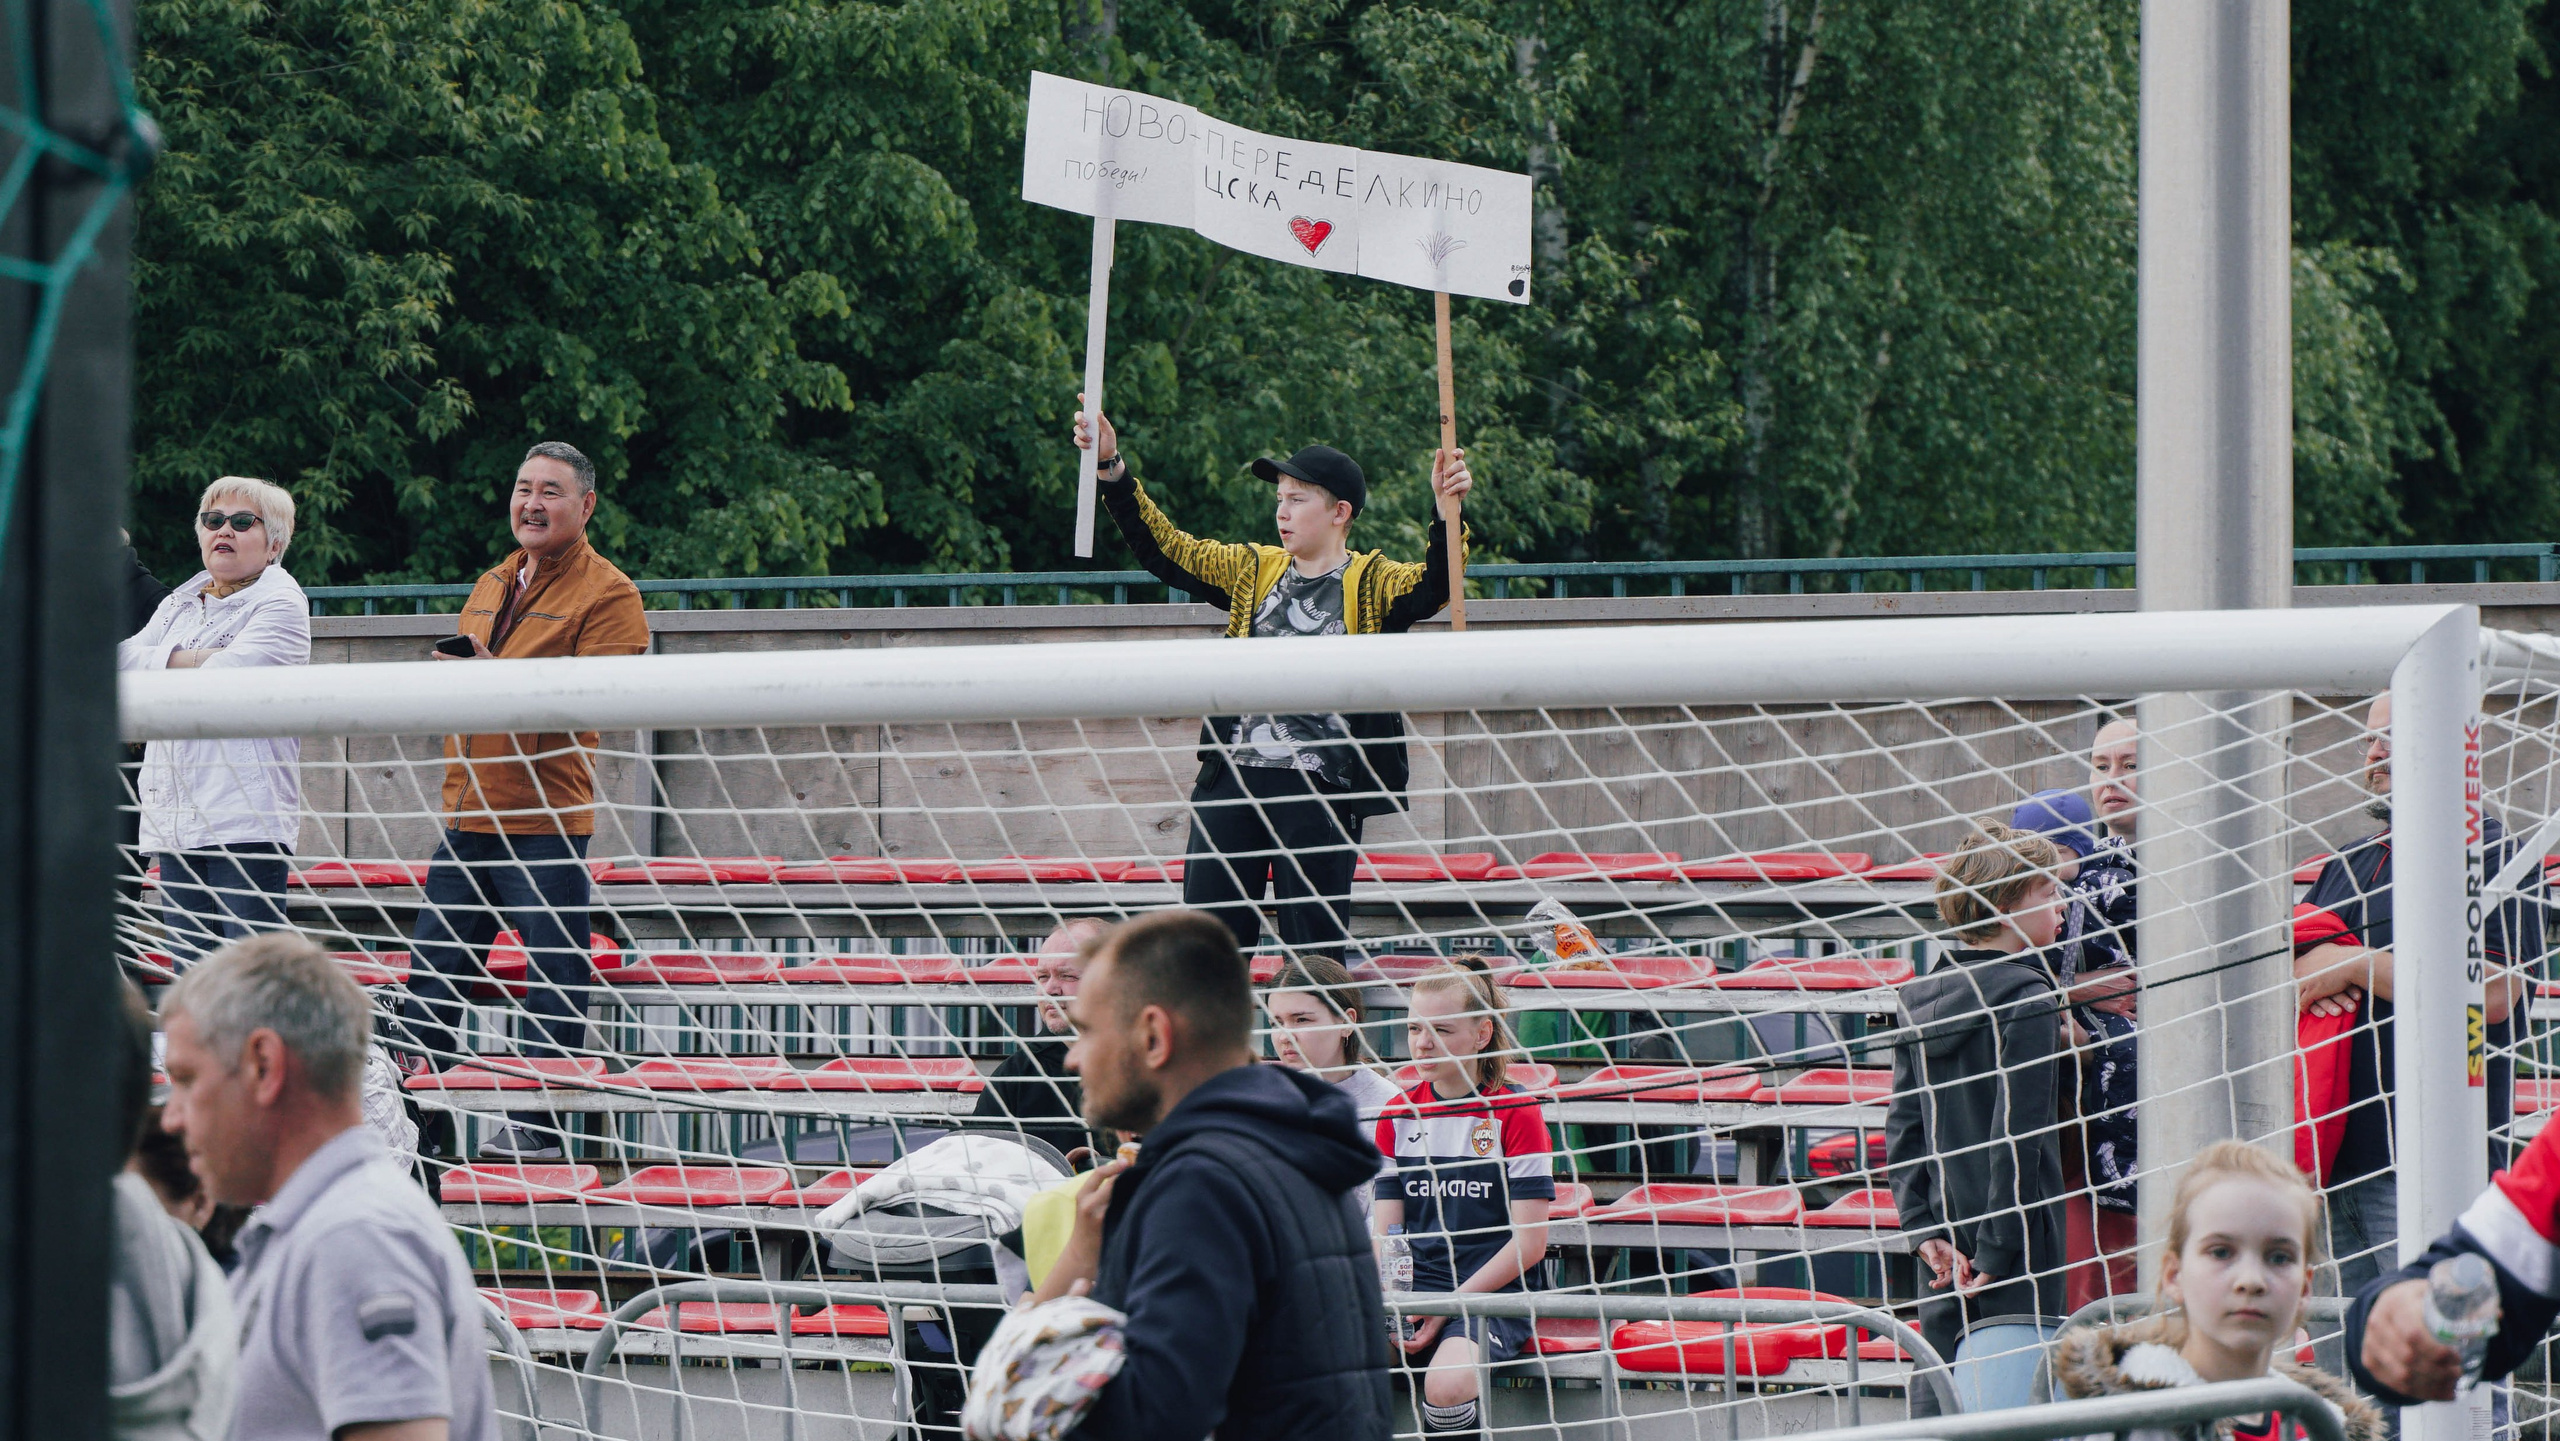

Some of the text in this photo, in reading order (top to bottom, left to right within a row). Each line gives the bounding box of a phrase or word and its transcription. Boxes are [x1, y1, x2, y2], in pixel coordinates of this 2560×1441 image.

[1083, 92, 1482, 216] НОВО-ПЕРЕДЕЛКИНО
[1204, 164, 1282, 212] ЦСКА
[2464, 722, 2483, 984] SPORTWERK
[2467, 1006, 2483, 1078] SW
